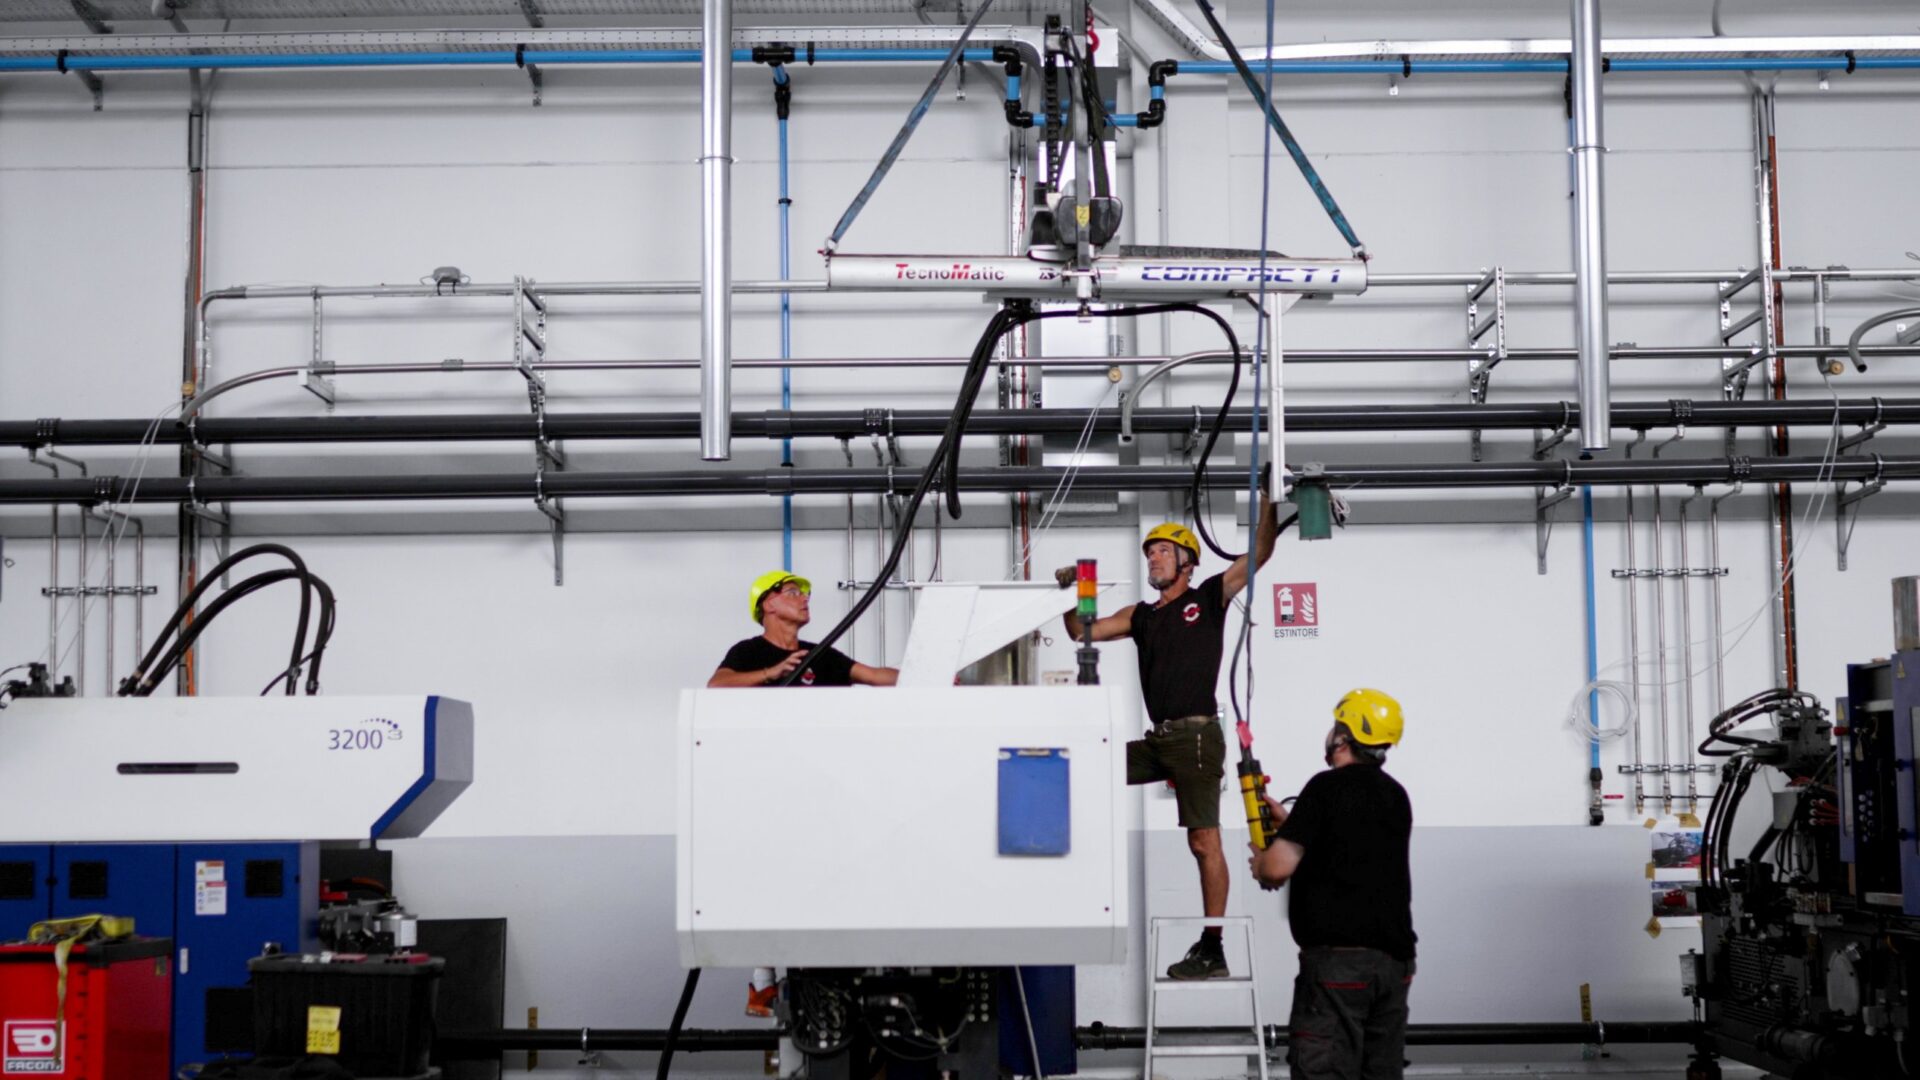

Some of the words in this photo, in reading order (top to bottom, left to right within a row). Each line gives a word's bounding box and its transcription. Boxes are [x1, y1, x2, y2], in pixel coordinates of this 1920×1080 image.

[896, 263, 1005, 281] TecnoMatic
[1141, 266, 1320, 283] COMPACT
[1274, 628, 1319, 638] ESTINTORE
